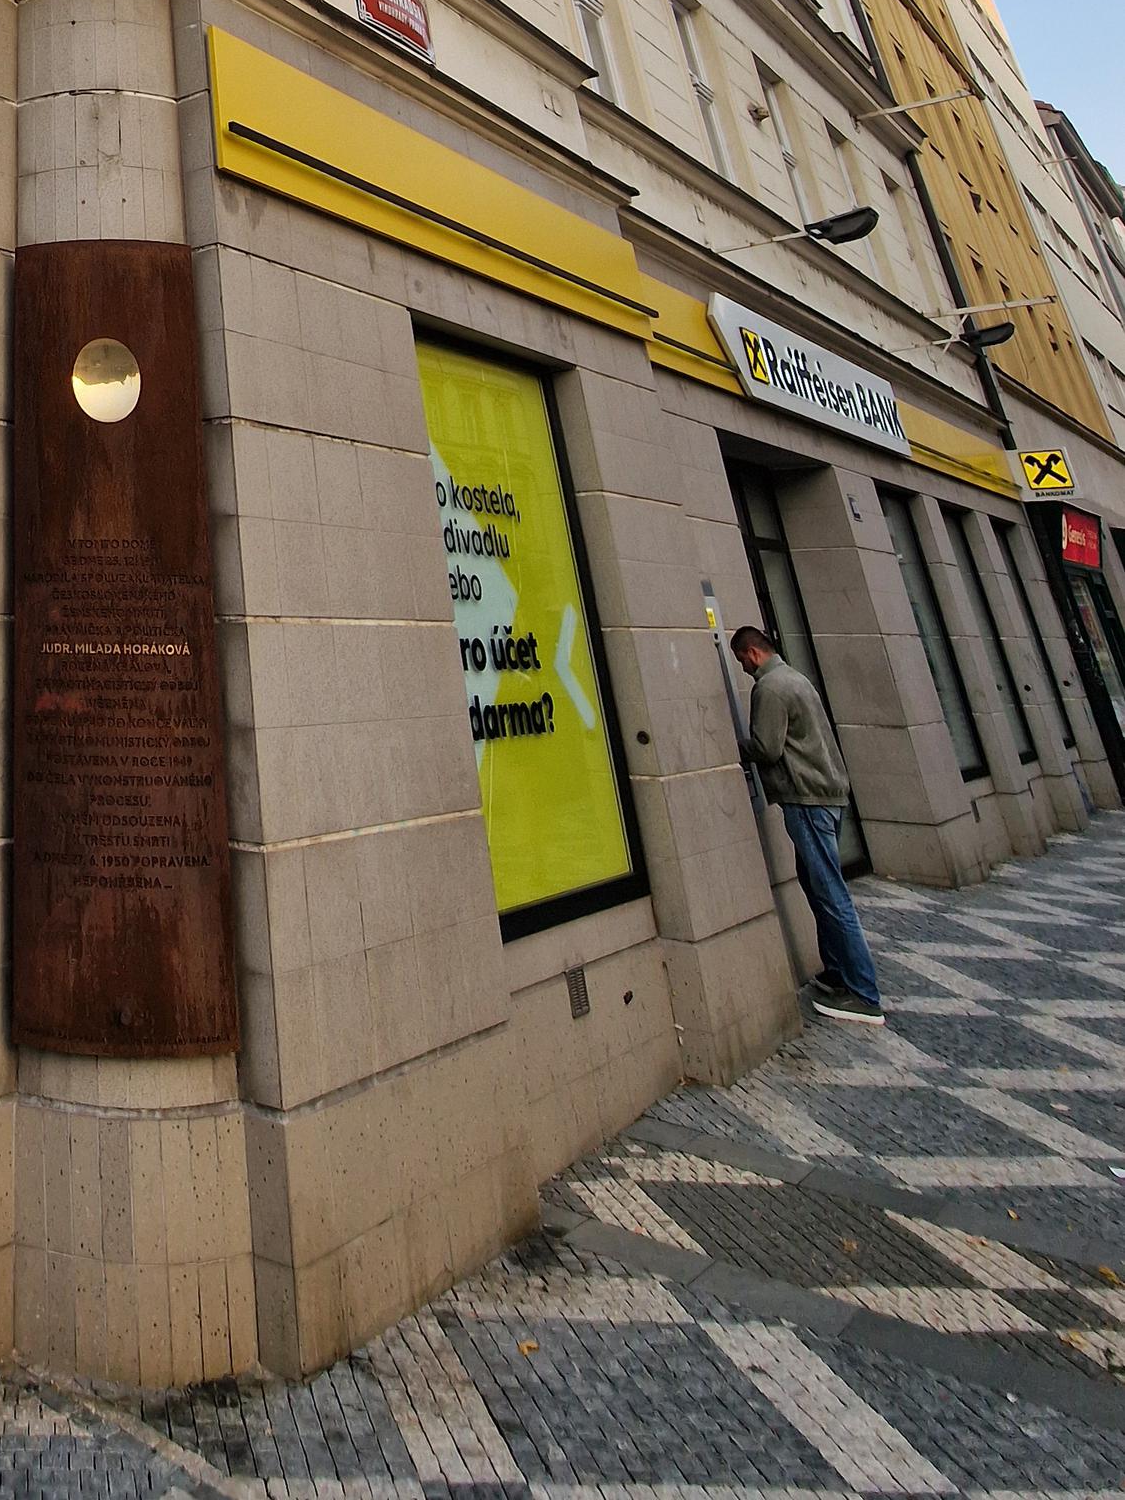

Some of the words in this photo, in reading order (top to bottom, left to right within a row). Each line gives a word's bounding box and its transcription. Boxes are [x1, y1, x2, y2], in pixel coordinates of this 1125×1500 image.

[760, 336, 861, 422] Raiffeisen
[854, 382, 907, 440] BANK
[450, 475, 521, 523] kostela,
[1035, 490, 1075, 498] BANKOMAT
[443, 519, 511, 558] divadlu
[41, 643, 73, 653] JUDR.
[74, 643, 121, 655] MILADA
[123, 641, 191, 656] HORÁKOVÁ
[490, 625, 541, 671] účet
[469, 691, 555, 741] darma?
